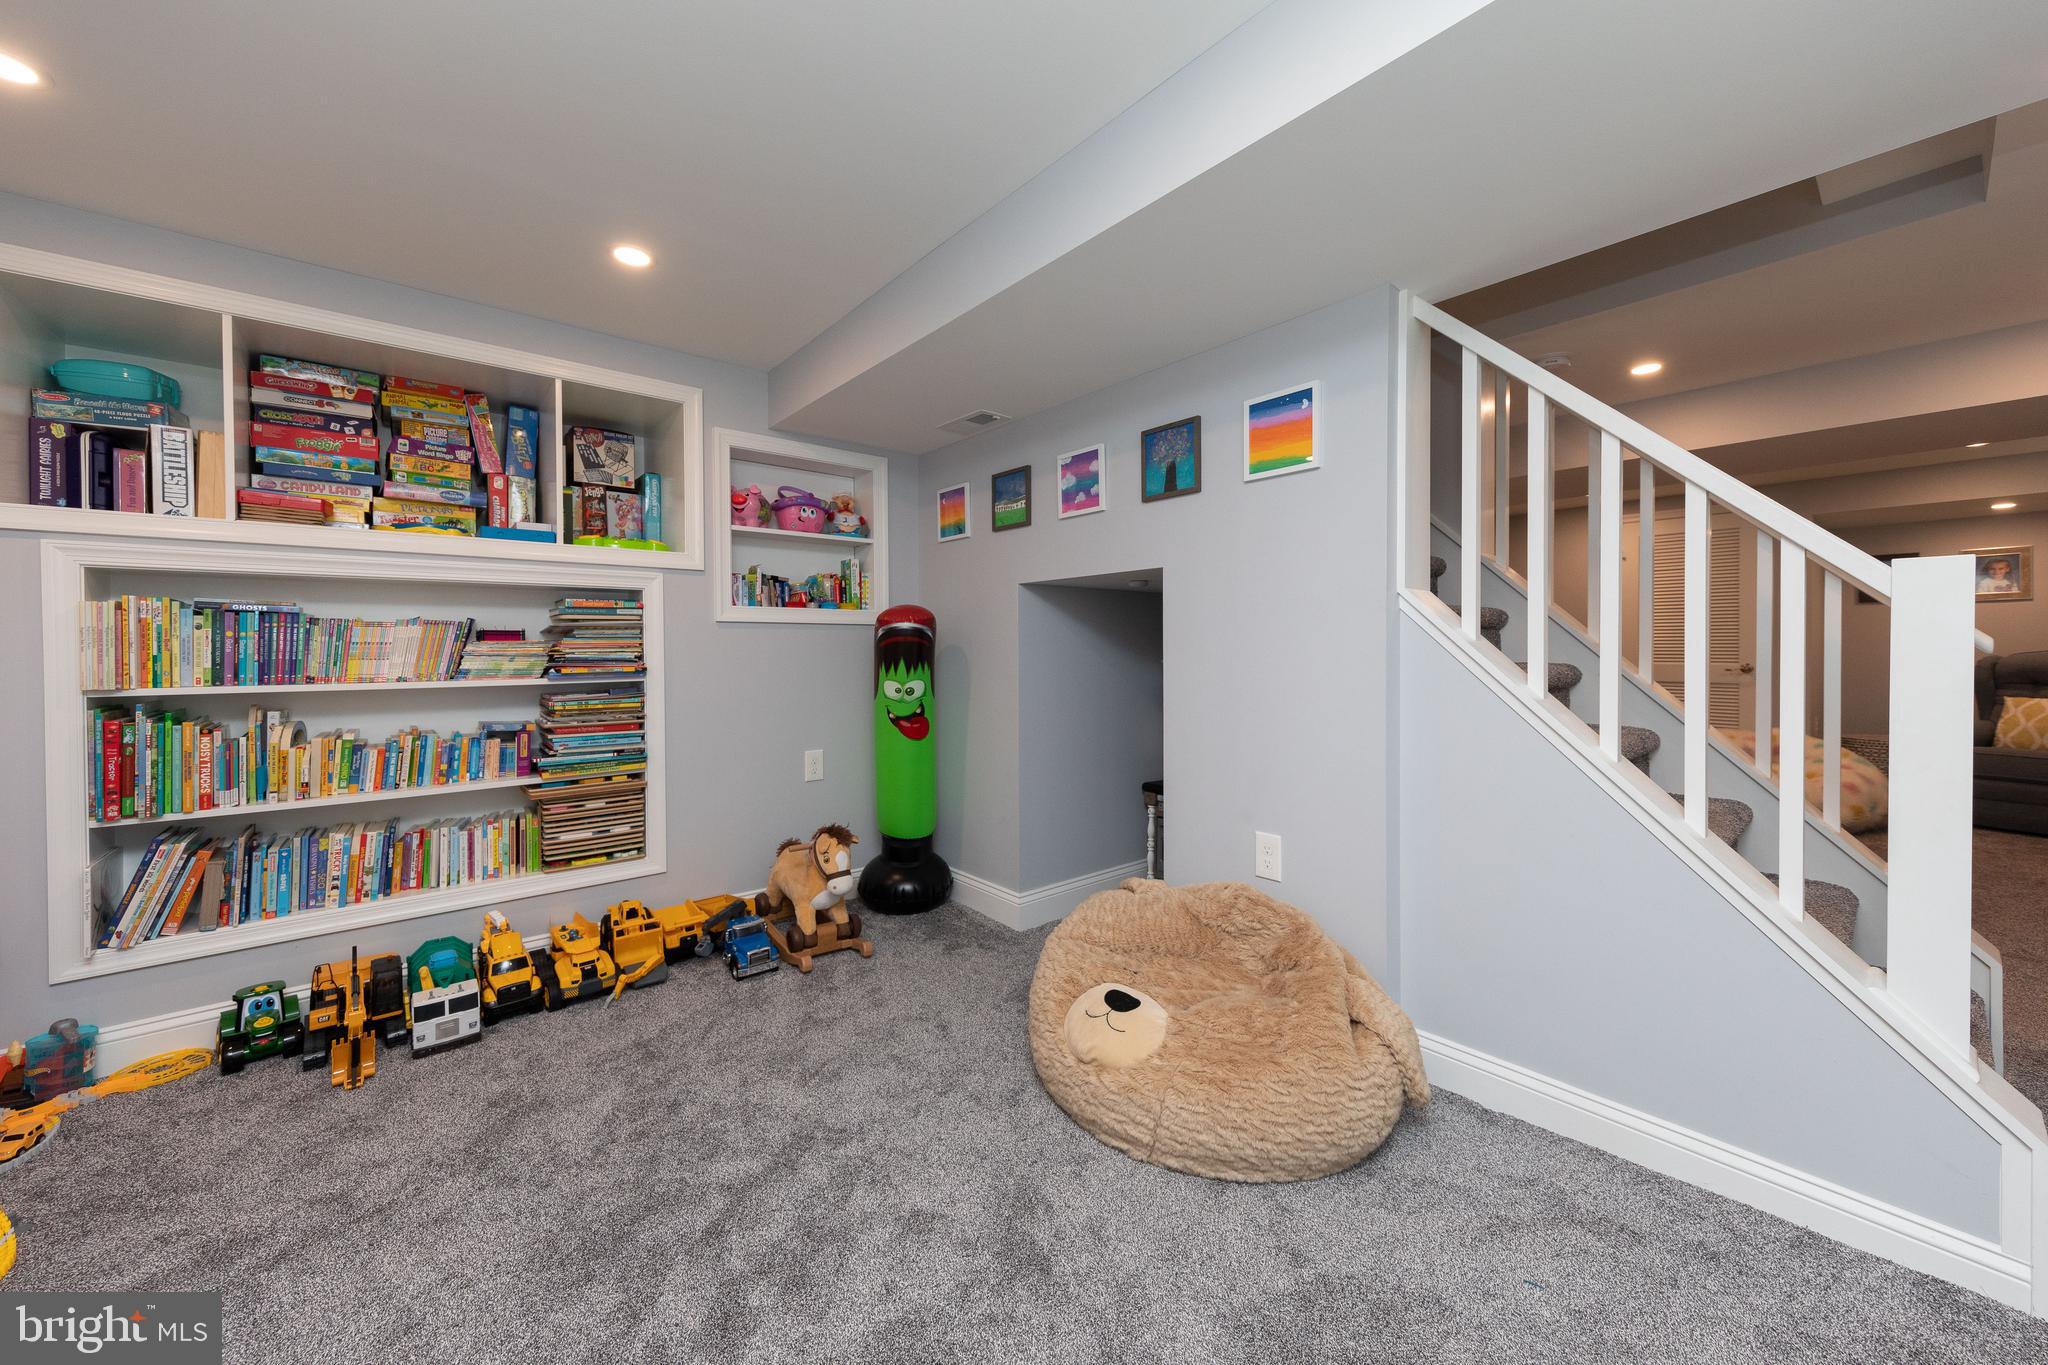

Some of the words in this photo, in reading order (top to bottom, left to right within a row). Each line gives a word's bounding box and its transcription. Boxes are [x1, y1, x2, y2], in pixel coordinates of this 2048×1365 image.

[417, 449, 435, 457] Word
[435, 452, 454, 460] Bingo
[162, 430, 187, 508] BATTLESHIP
[40, 465, 51, 500] TWILIGHT
[280, 480, 326, 493] CANDY
[328, 484, 361, 497] LAND
[584, 486, 605, 497] Jenga
[492, 495, 501, 528] CHARADE
[232, 604, 268, 612] GHOSTS
[200, 737, 210, 761] NOISY
[108, 757, 117, 781] Tractor
[200, 762, 210, 794] TRUCKS
[332, 847, 341, 872] TRUCK?
